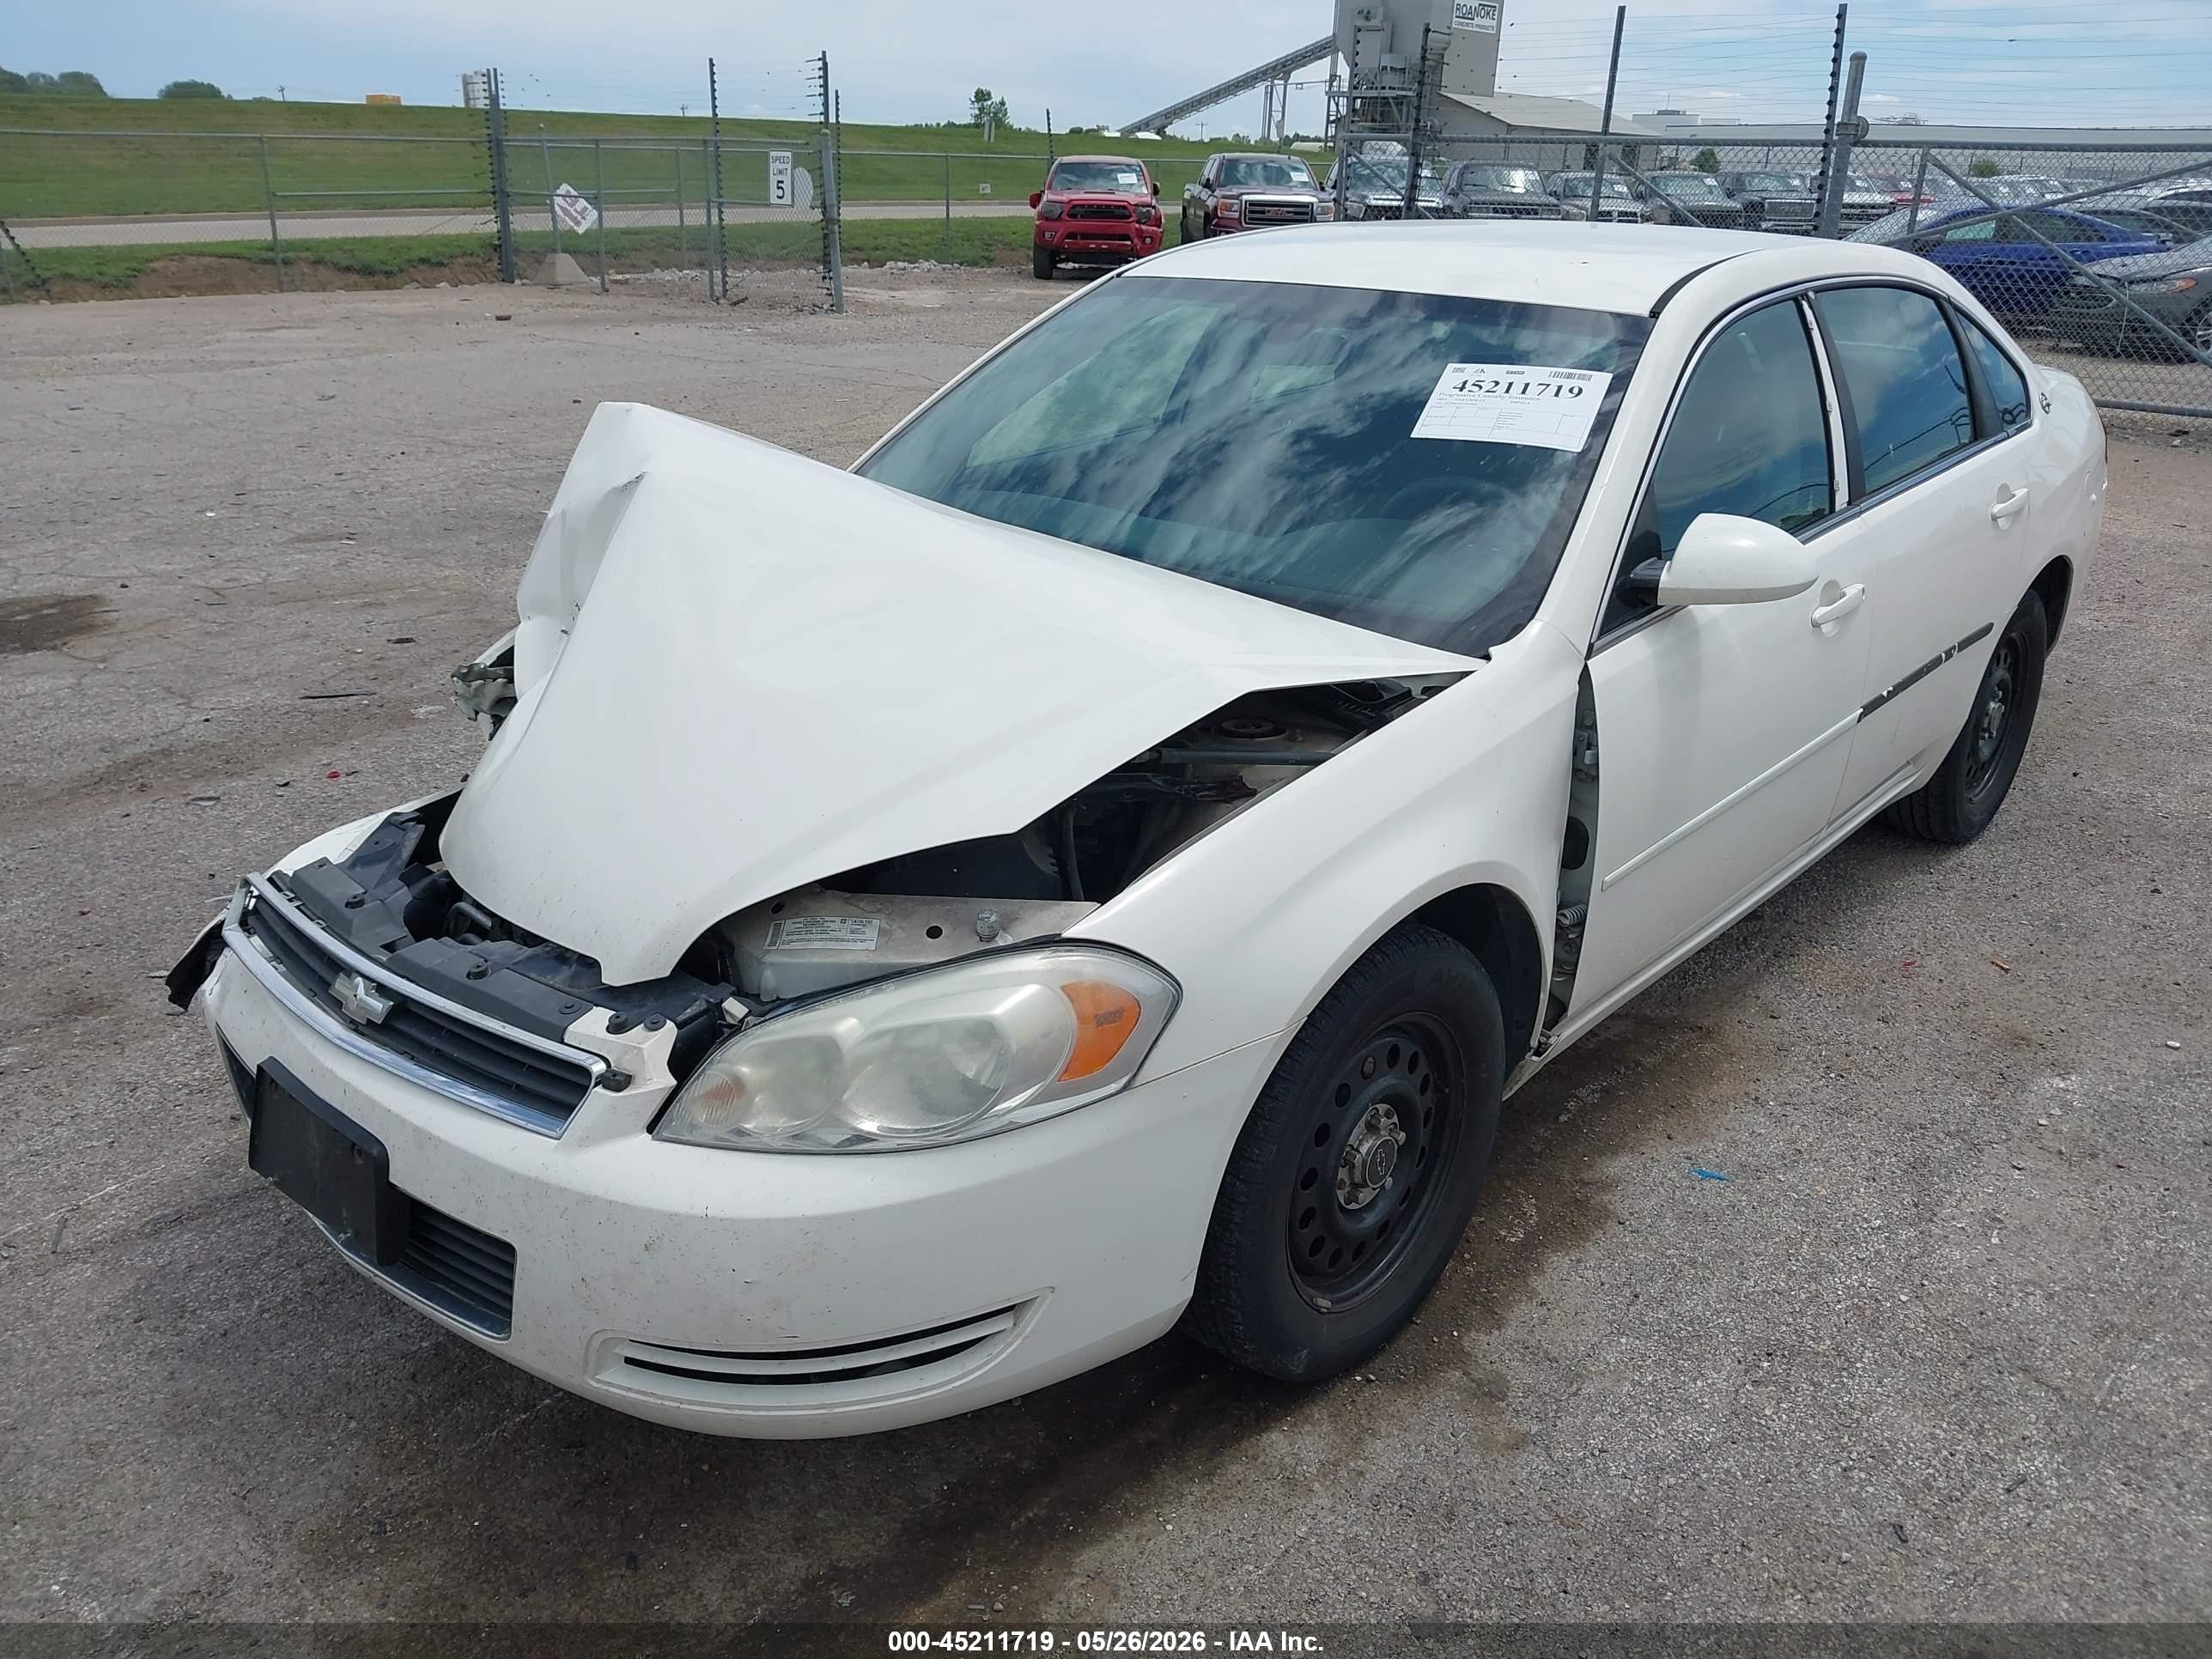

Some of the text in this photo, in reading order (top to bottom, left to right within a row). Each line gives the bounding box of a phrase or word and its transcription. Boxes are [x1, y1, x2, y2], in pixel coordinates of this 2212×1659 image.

[1455, 3, 1498, 21] ROANOKE
[1474, 23, 1495, 32] PRODUCTS
[771, 155, 790, 164] SPEED
[772, 168, 788, 177] LIMIT
[775, 179, 785, 199] 5
[1452, 379, 1584, 399] 45211719
